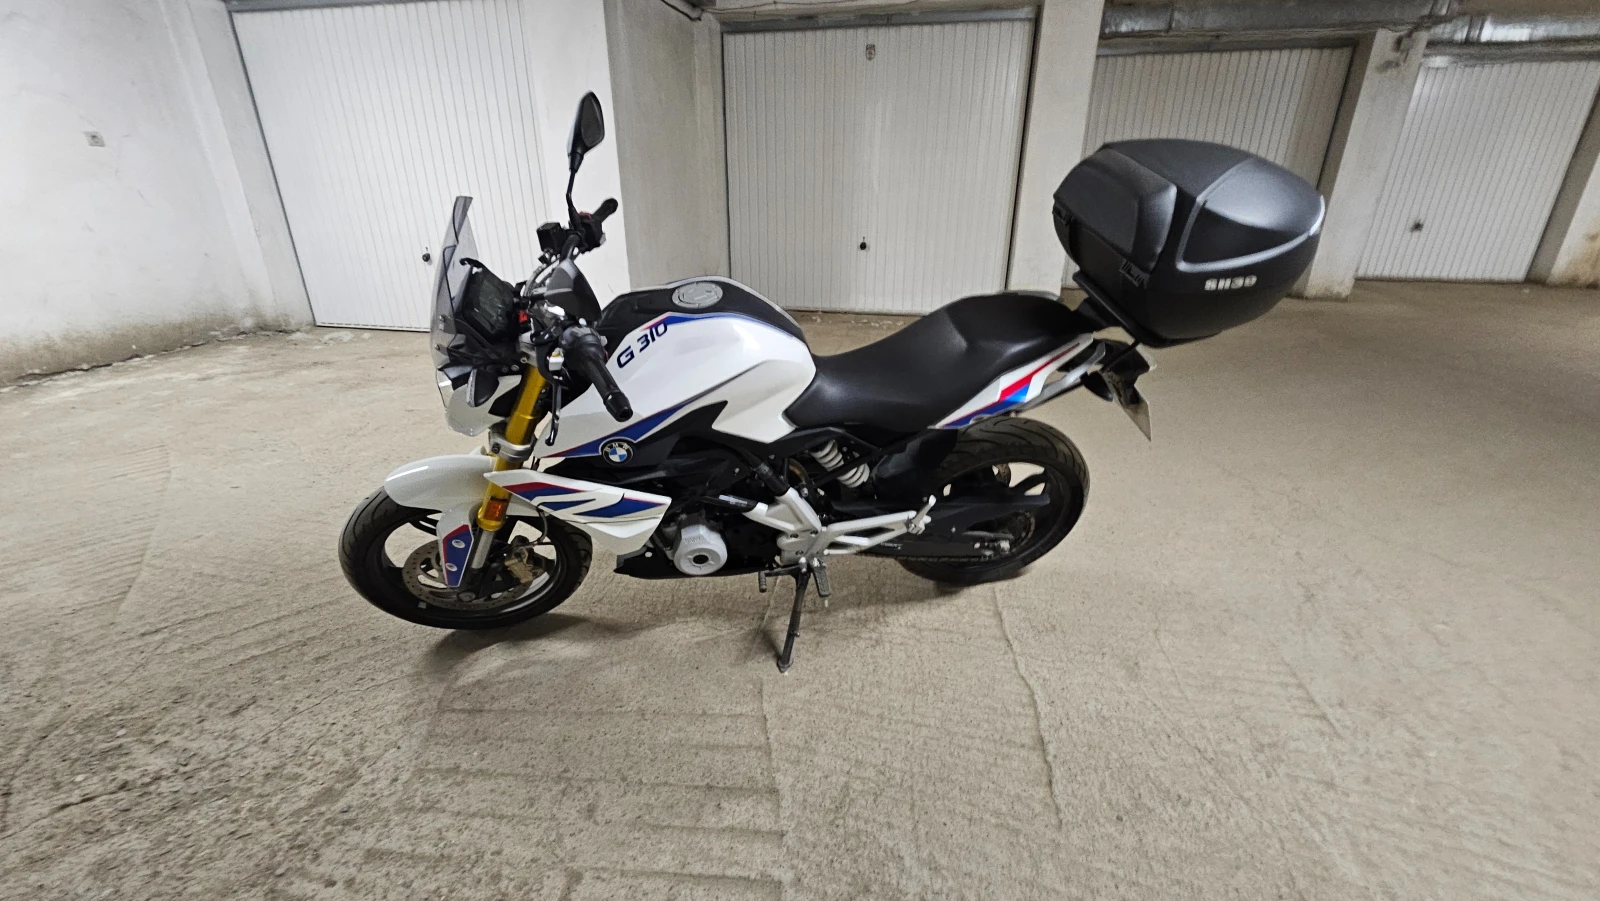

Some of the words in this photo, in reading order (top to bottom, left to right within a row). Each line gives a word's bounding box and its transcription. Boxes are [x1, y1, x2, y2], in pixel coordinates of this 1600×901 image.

[616, 345, 635, 369] G
[636, 321, 668, 353] 310
[604, 442, 631, 453] BMW
